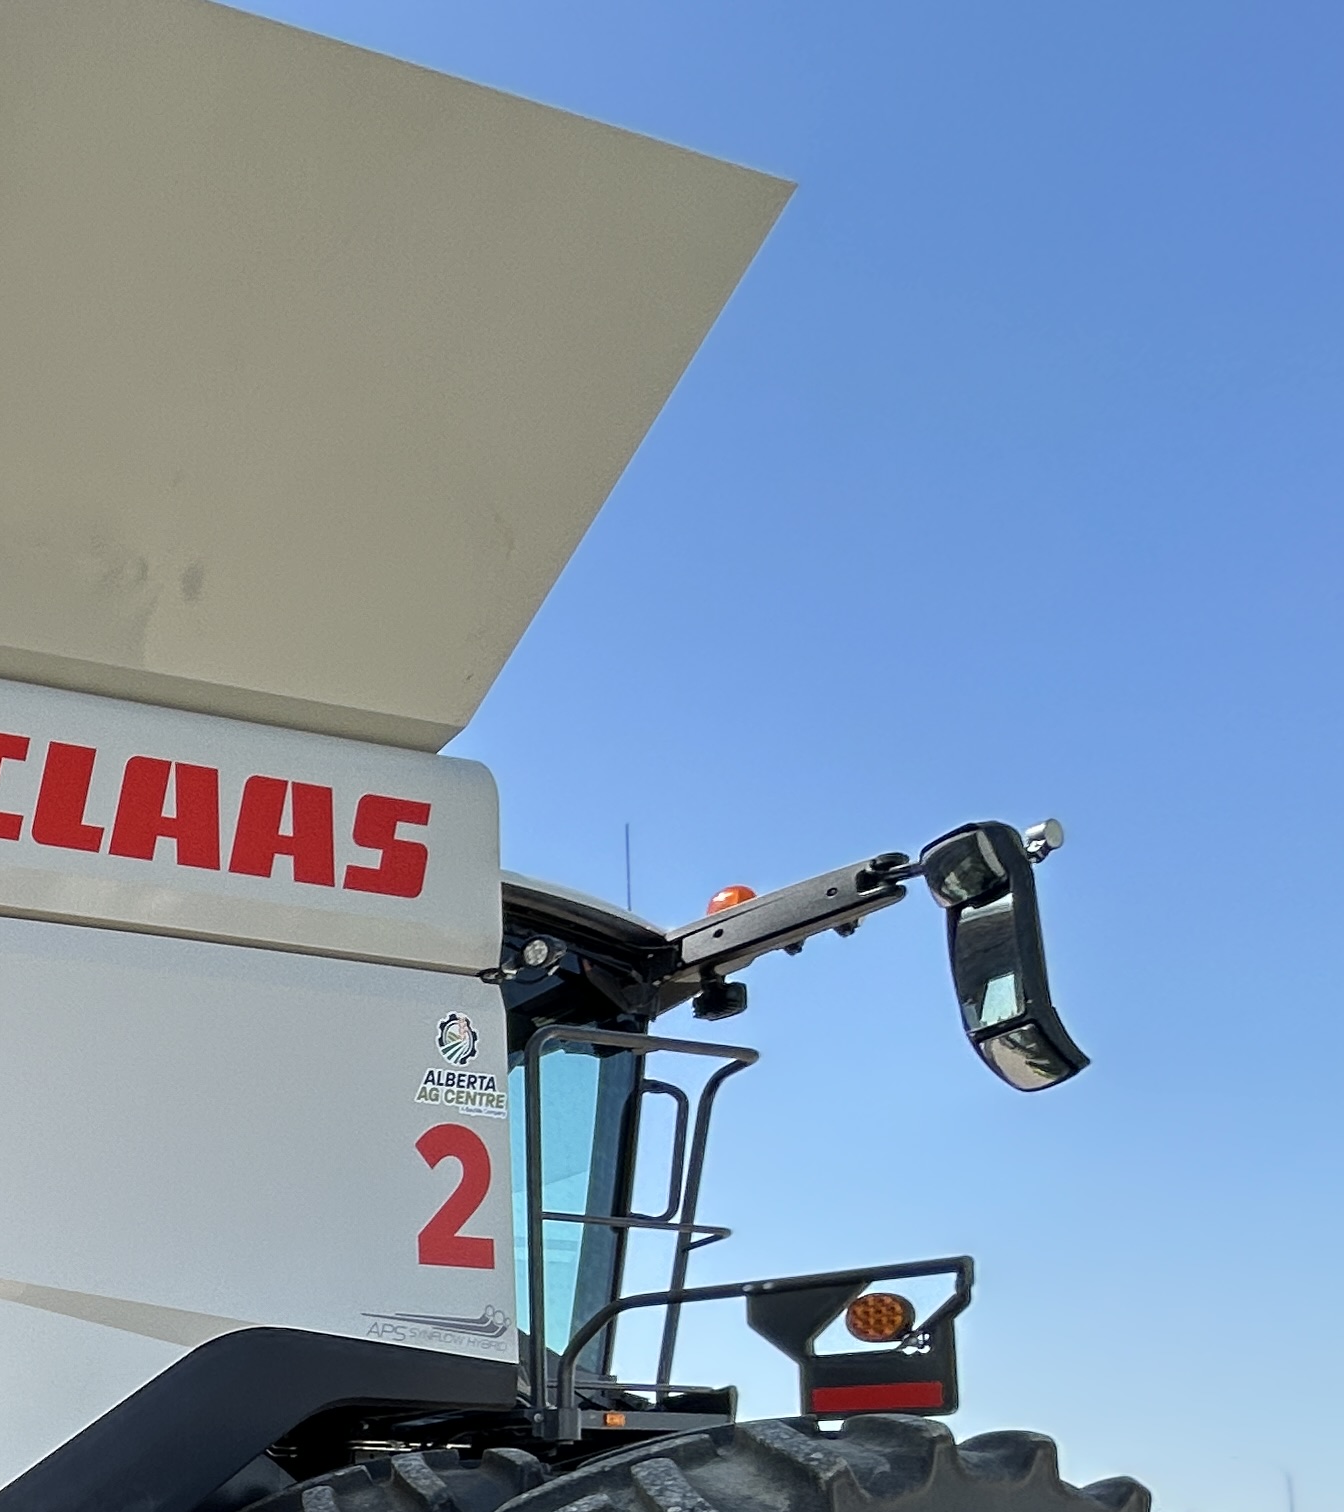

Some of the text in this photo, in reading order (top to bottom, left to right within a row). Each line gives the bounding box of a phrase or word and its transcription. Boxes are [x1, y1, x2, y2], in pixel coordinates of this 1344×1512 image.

[423, 1069, 496, 1092] ALBERTA
[416, 1086, 506, 1109] AG CENTRE
[414, 1123, 496, 1270] 2
[366, 1321, 508, 1352] APS SYNFLOW HYBRID
